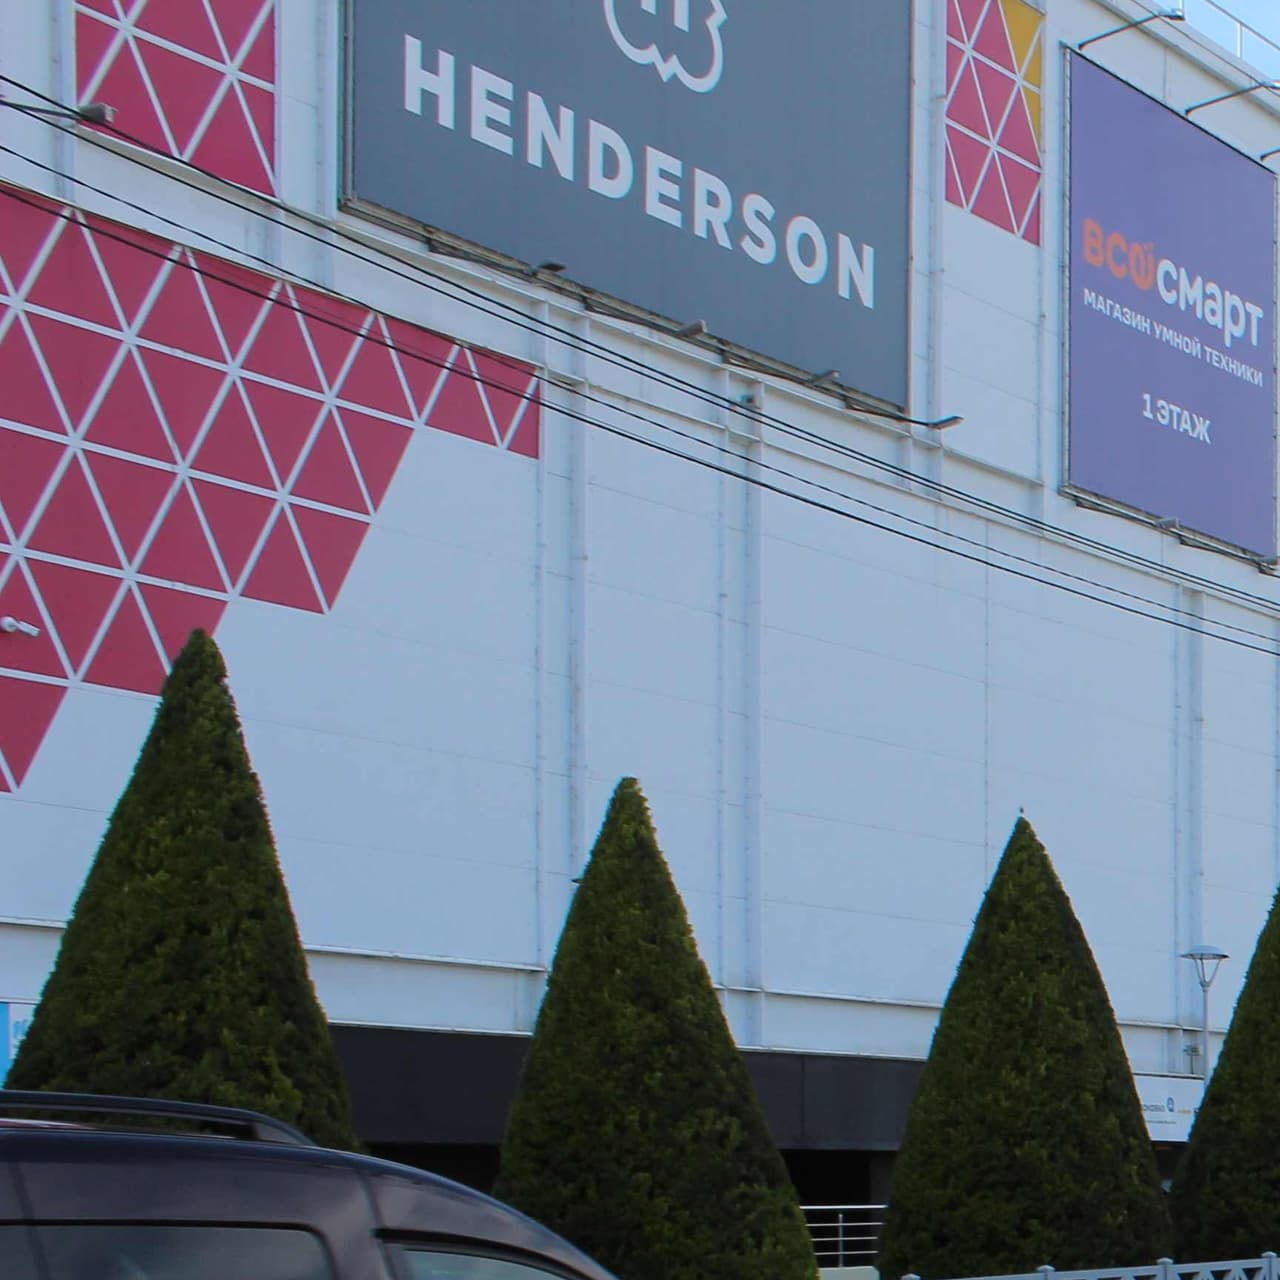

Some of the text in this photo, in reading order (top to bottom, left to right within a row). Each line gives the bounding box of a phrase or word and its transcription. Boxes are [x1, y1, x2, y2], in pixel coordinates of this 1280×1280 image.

[404, 33, 875, 310] HENDERSON
[1083, 287, 1264, 387] МАГАЗИН УМНОЙ ТЕХНИКИ
[1142, 393, 1212, 444] 1 ЭТАЖ
